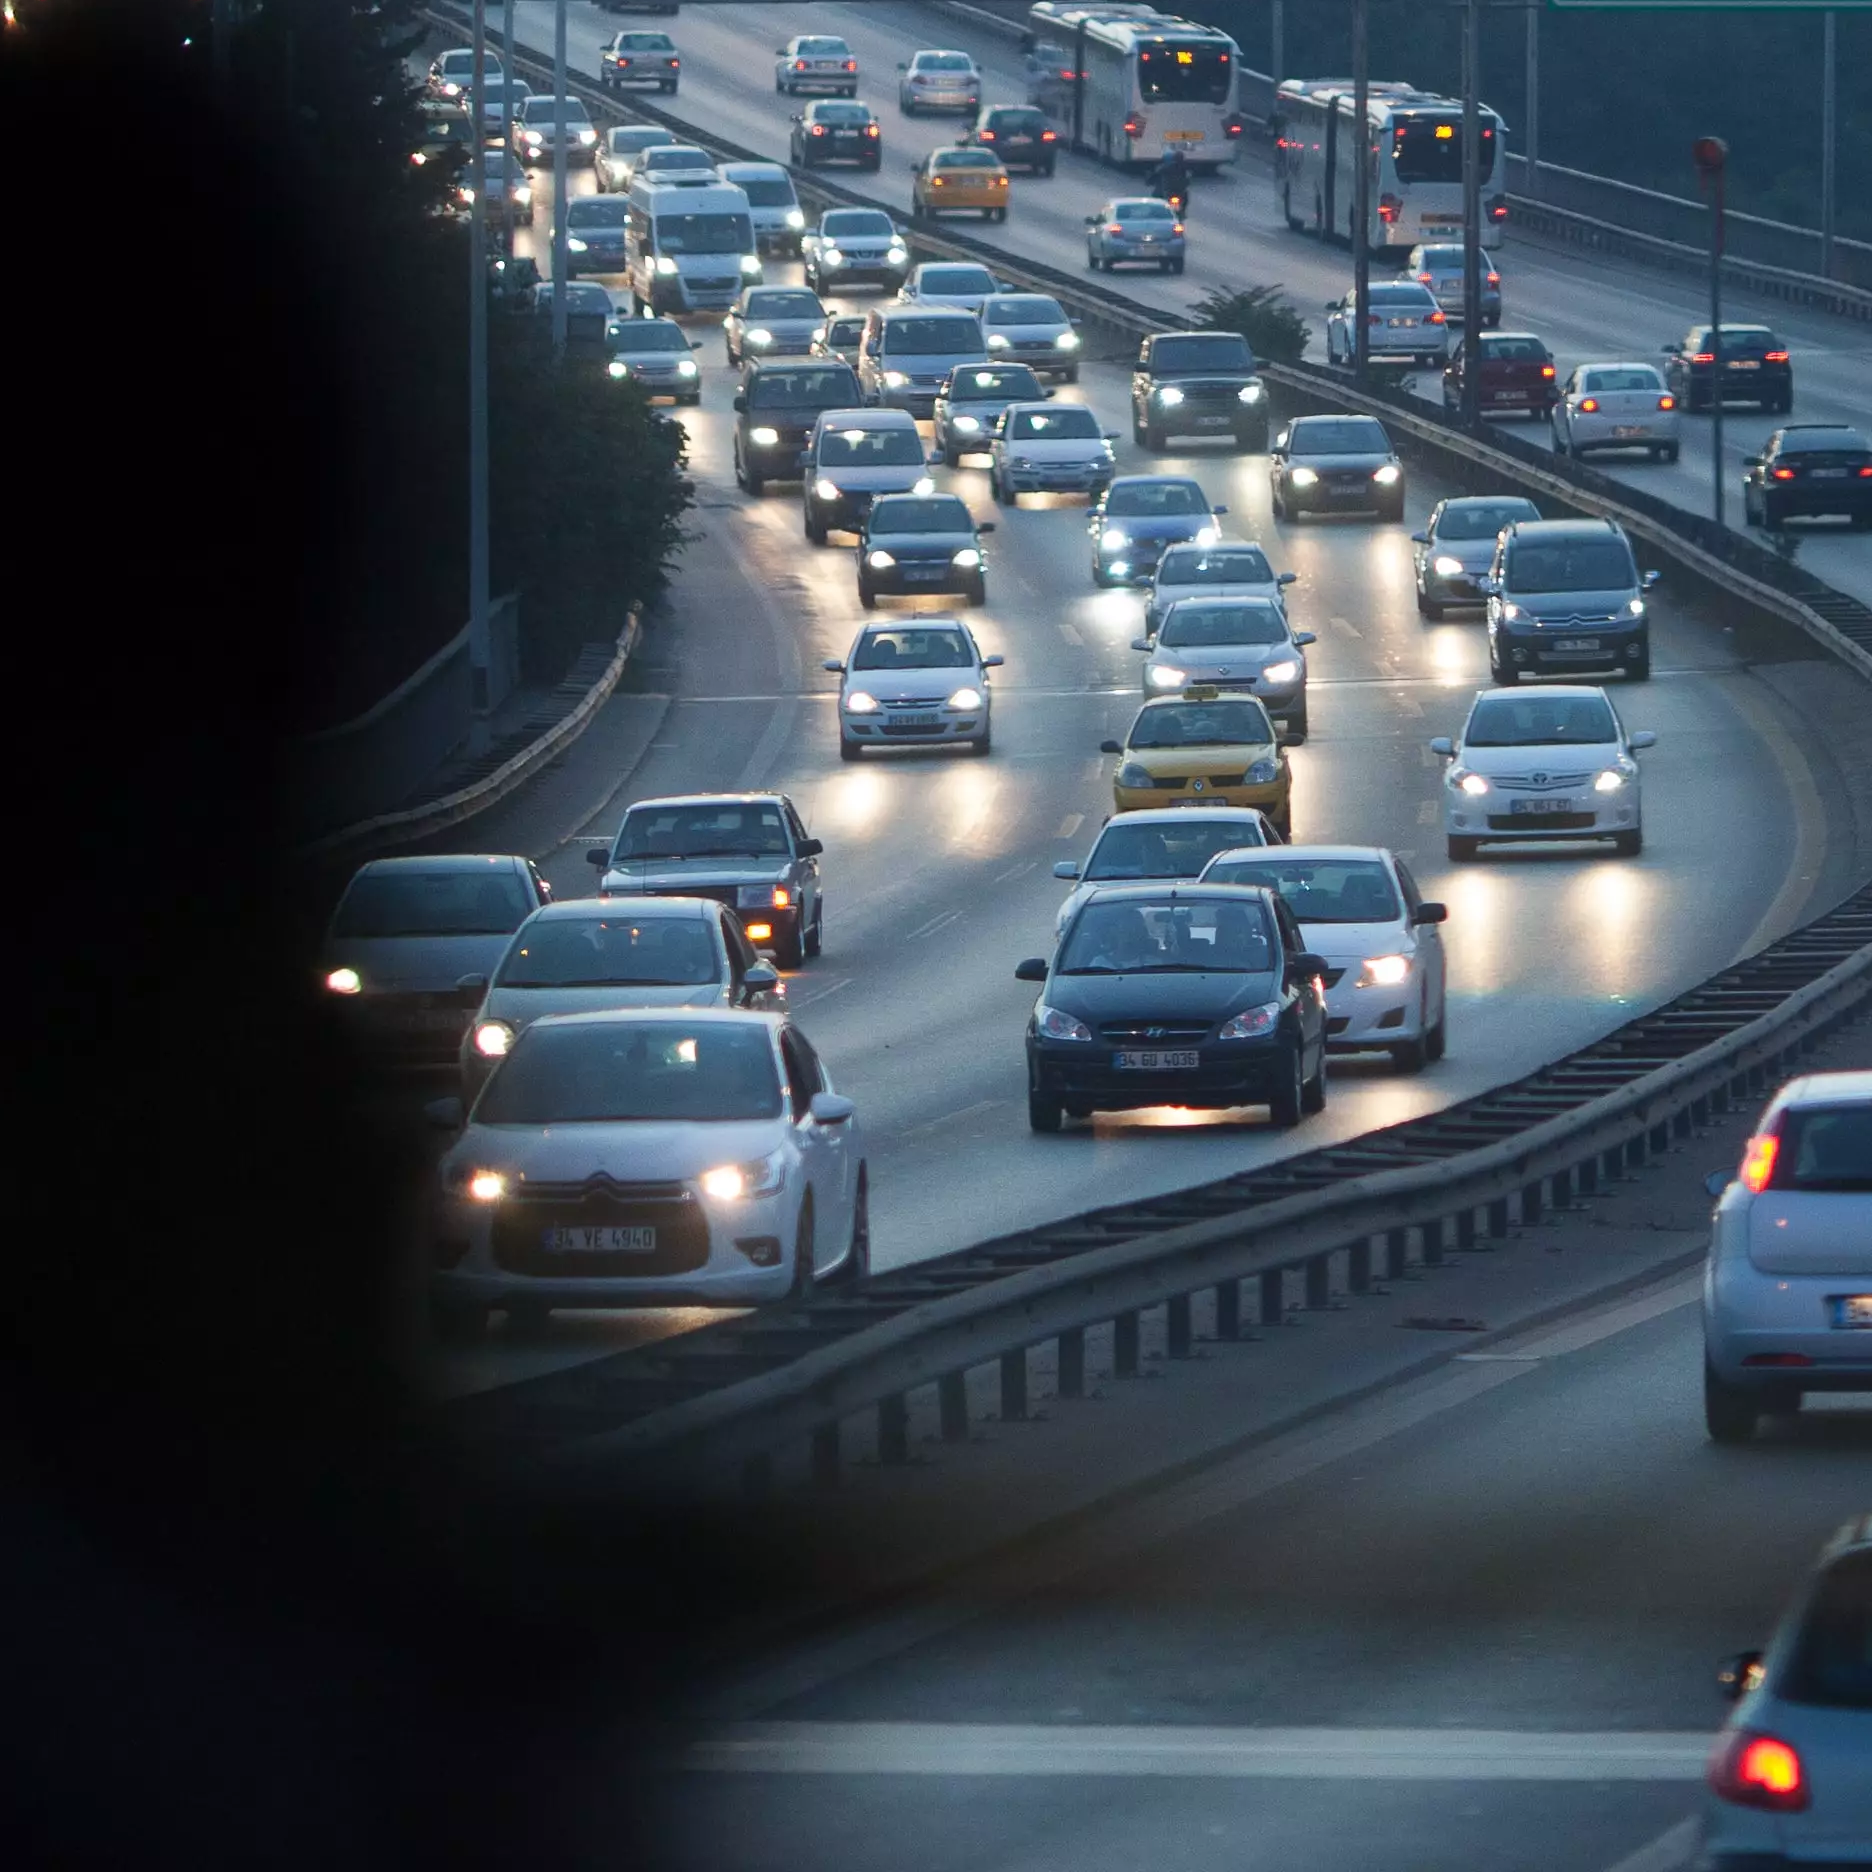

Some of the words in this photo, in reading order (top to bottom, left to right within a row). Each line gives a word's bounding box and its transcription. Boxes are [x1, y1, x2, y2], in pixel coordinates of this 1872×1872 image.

[1119, 1053, 1136, 1067] 34
[555, 1227, 574, 1247] 34
[583, 1227, 603, 1248] YE
[612, 1227, 653, 1248] 4940
